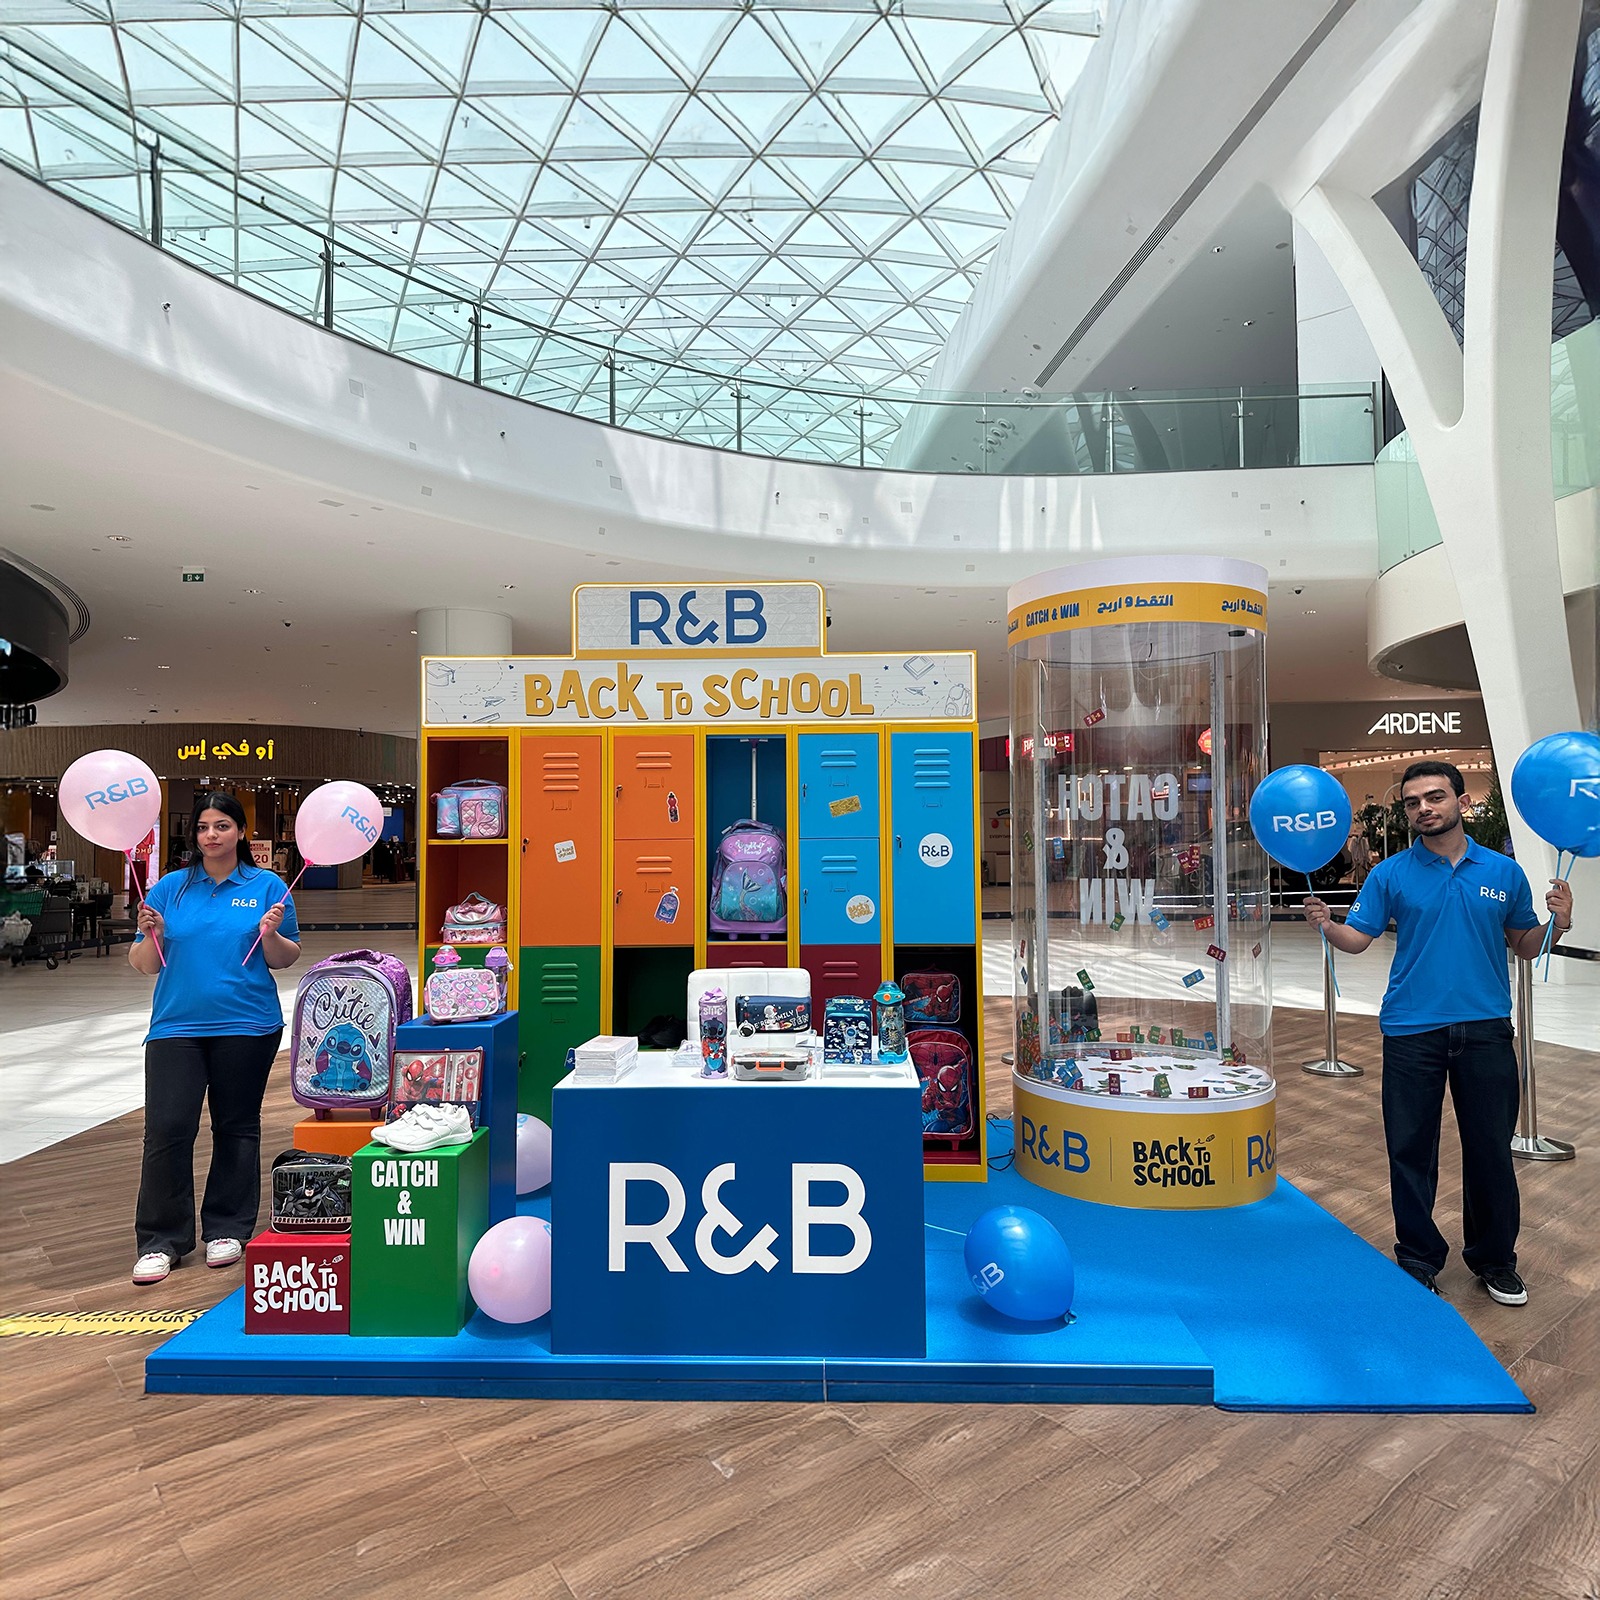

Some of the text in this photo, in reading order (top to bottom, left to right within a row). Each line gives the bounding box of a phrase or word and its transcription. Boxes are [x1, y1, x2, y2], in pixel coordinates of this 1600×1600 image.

[1134, 595, 1173, 607] التقط
[630, 590, 767, 645] R&B
[1026, 608, 1049, 627] CATCH
[1051, 608, 1058, 620] &
[1060, 603, 1079, 619] WIN
[524, 662, 648, 720] BACK
[702, 668, 875, 718] SCHOOL
[1367, 712, 1461, 735] ARDENE
[178, 739, 274, 760] أو في إس
[85, 777, 149, 810] R&B
[341, 806, 378, 843] R&B
[1272, 810, 1337, 833] R&B
[921, 845, 950, 857] R&B
[231, 898, 258, 908] R&B
[1480, 886, 1507, 902] R&B
[313, 992, 375, 1030] Cutie
[1021, 1115, 1091, 1174] R&B
[1133, 1136, 1194, 1166] BACK
[371, 1160, 439, 1187] CATCH
[1133, 1163, 1216, 1188] SCHOOL
[397, 1190, 412, 1214] &
[384, 1218, 425, 1245] WIN
[608, 1162, 872, 1275] R&B
[253, 1256, 318, 1289] BACK
[253, 1286, 343, 1313] SCHOOL
